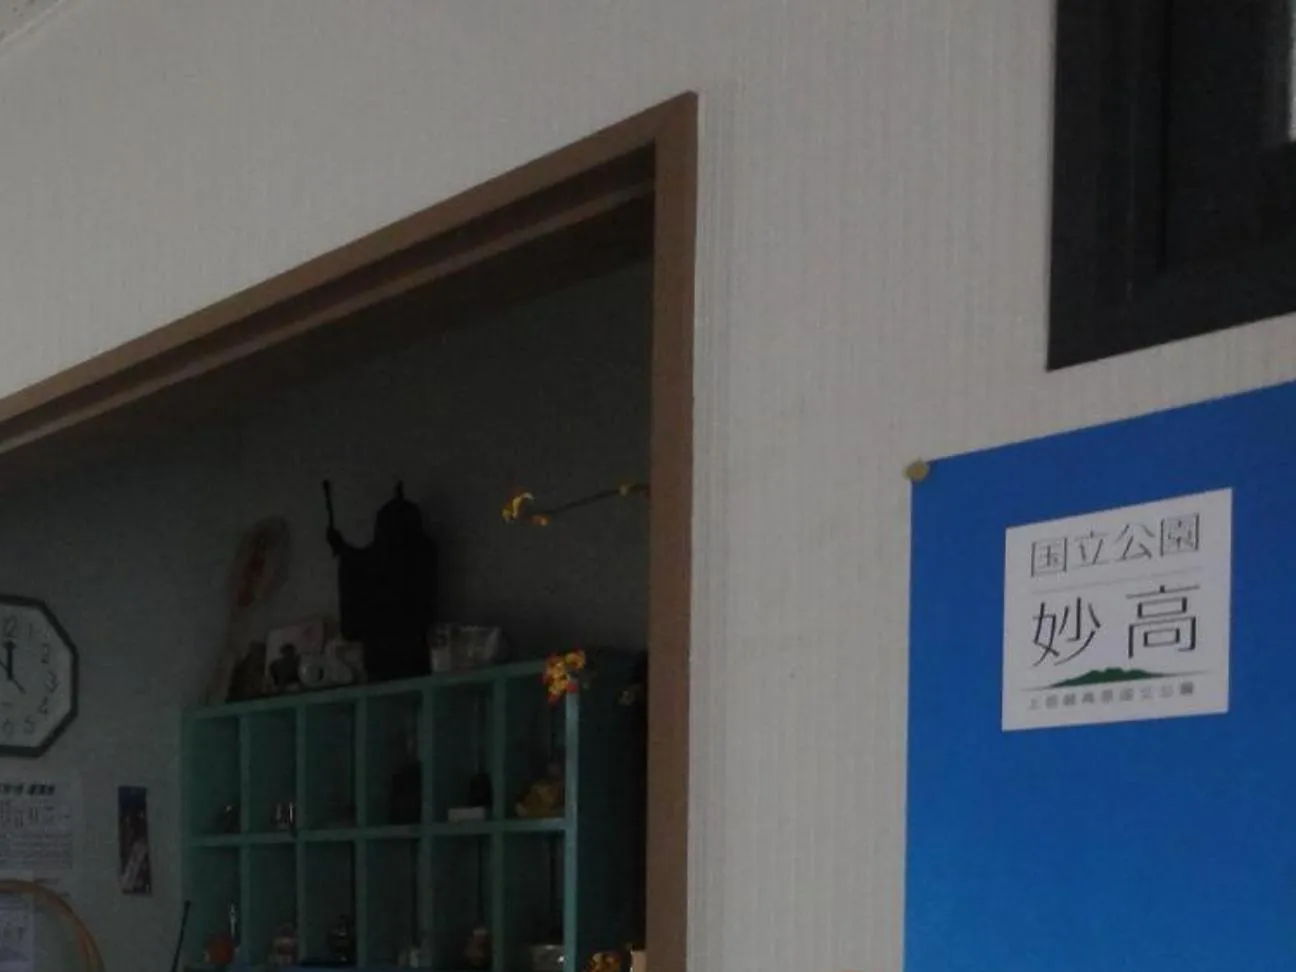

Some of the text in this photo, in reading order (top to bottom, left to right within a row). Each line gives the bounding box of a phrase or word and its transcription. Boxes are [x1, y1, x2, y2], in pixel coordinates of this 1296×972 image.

[1030, 512, 1200, 578] 国立公園
[1032, 585, 1201, 668] 妙高
